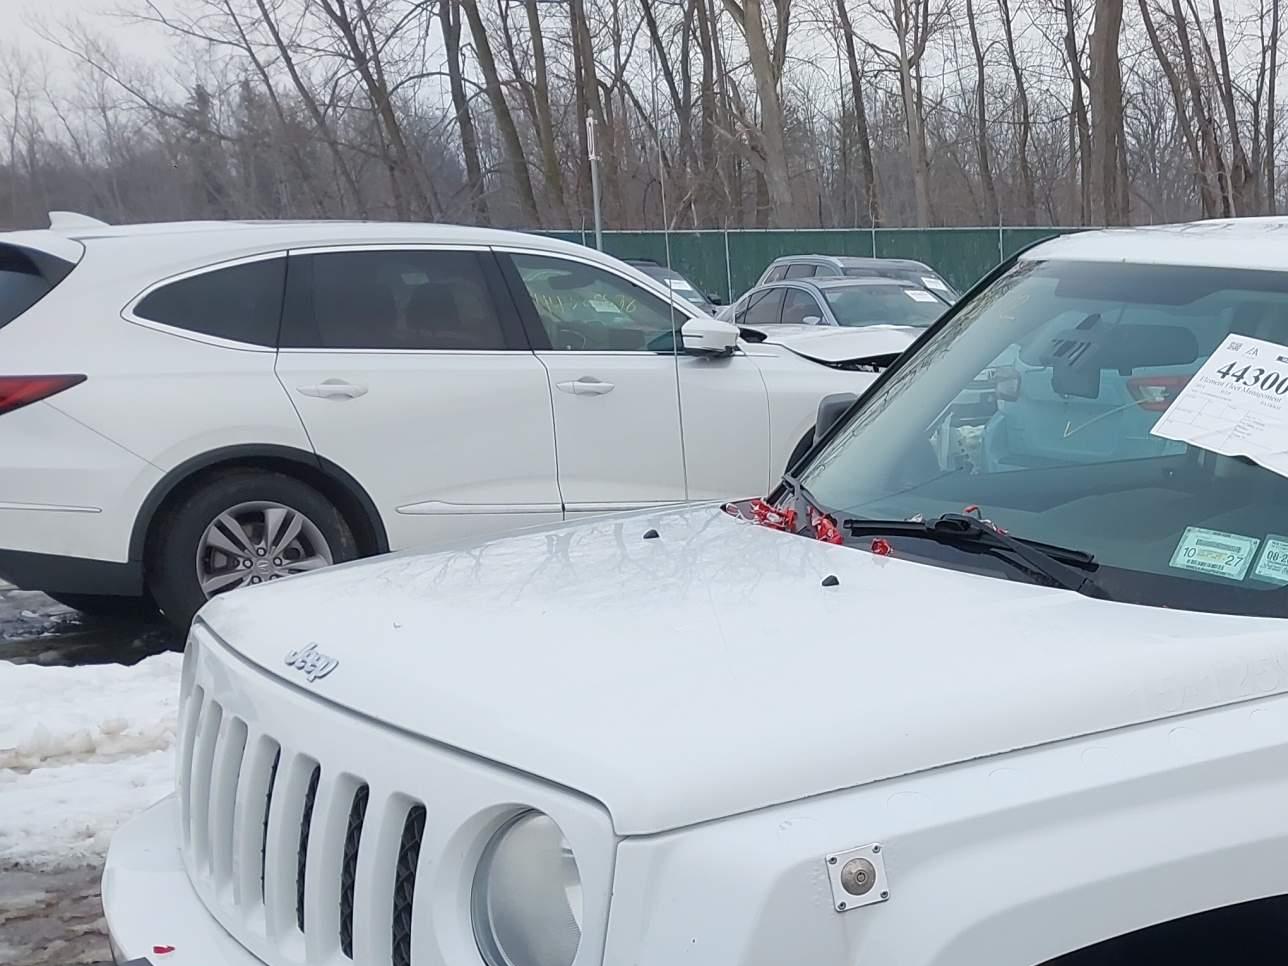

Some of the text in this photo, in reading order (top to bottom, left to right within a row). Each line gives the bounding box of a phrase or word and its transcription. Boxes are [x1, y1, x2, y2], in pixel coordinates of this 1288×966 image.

[1183, 546, 1197, 559] 10
[1224, 554, 1244, 567] 27
[285, 642, 339, 683] Jeep
